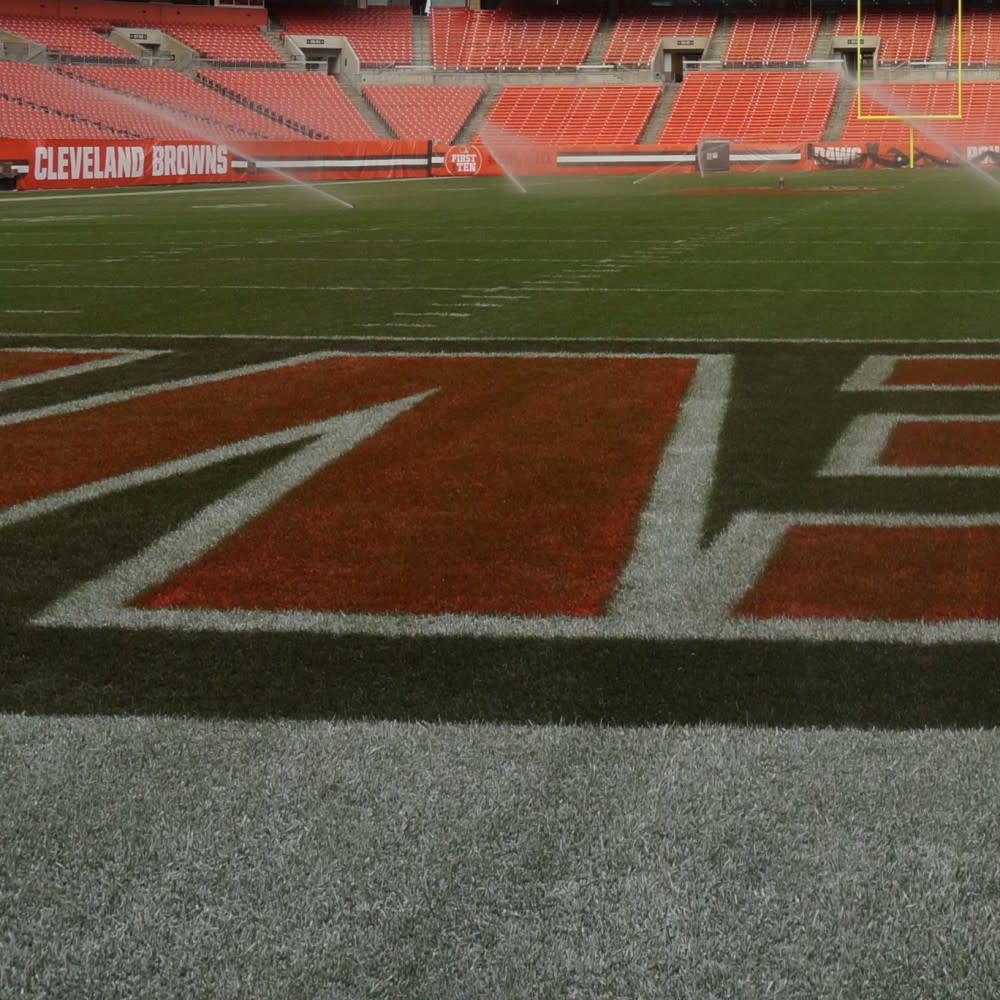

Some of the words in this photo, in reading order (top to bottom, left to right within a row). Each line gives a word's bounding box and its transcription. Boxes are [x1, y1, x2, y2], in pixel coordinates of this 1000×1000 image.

[34, 146, 145, 181] CLEVELAND
[151, 144, 228, 177] BROWNS
[451, 153, 477, 163] FIRST
[456, 162, 477, 172] TEN
